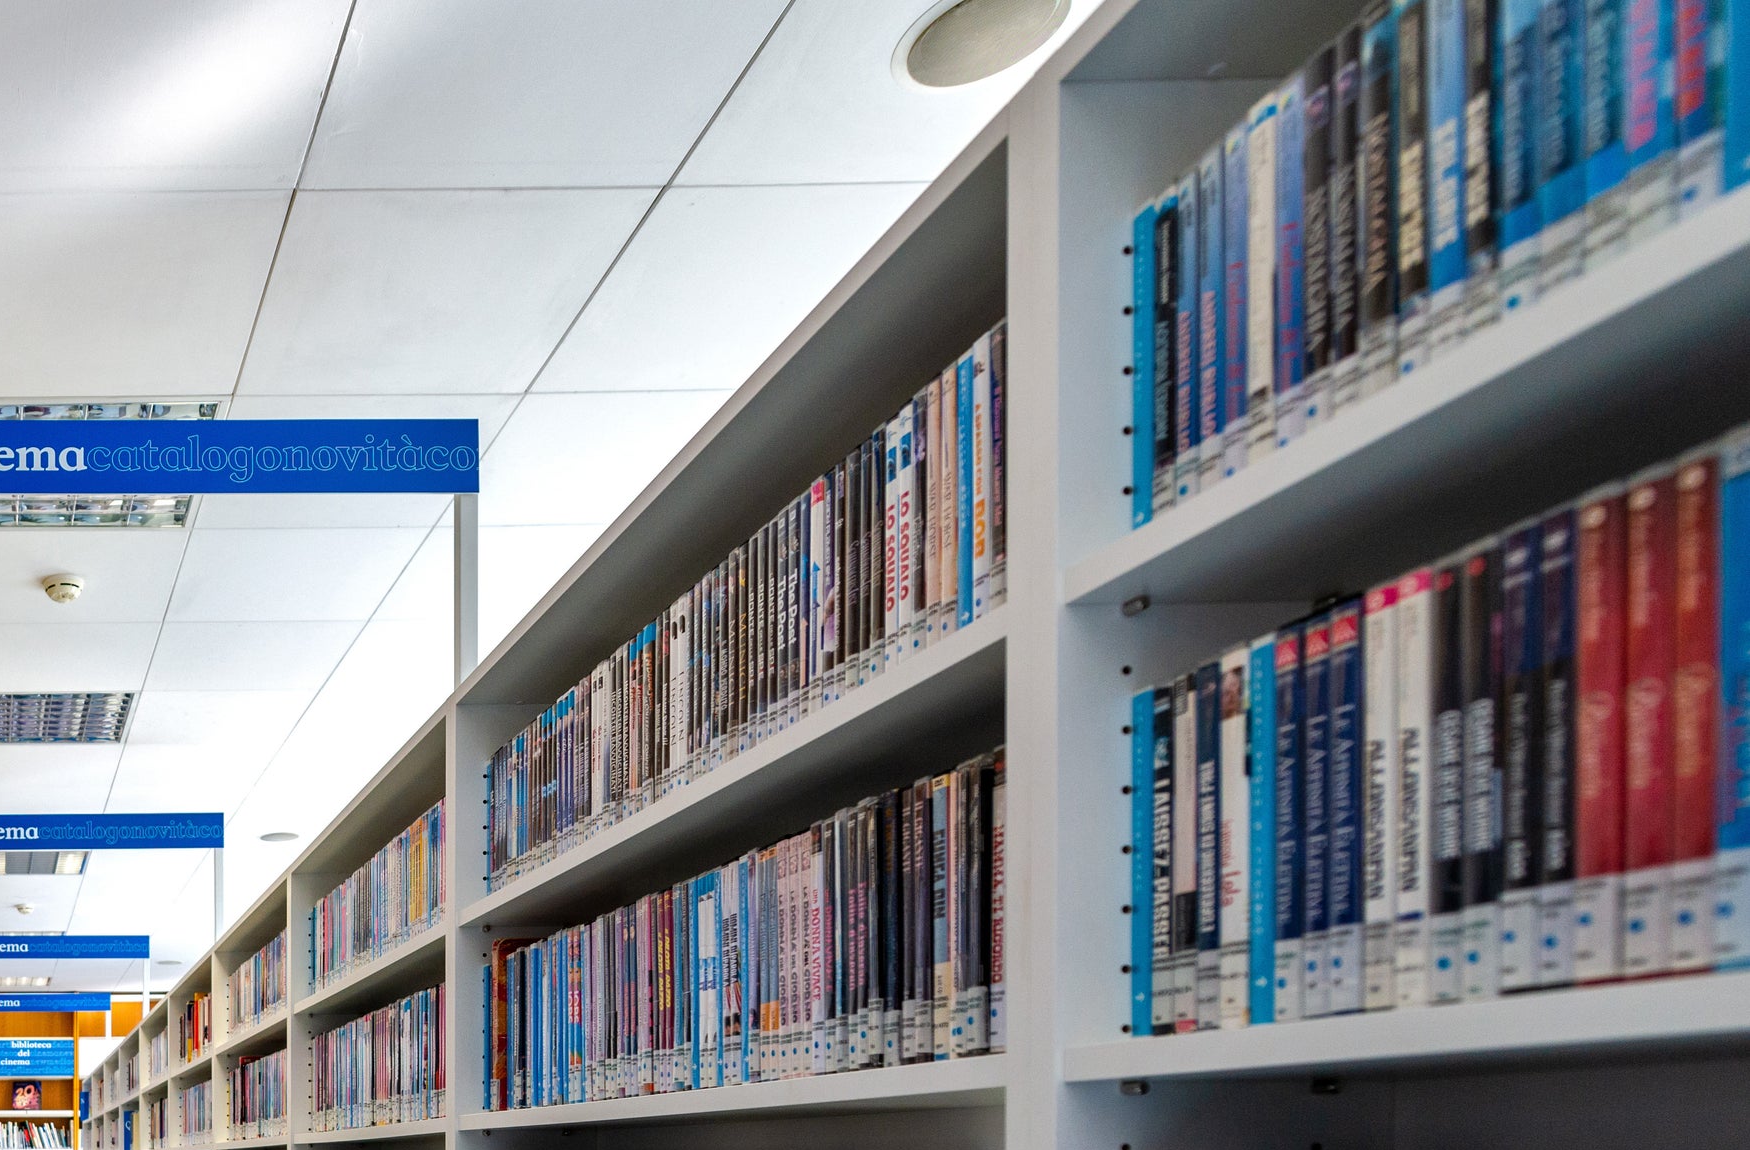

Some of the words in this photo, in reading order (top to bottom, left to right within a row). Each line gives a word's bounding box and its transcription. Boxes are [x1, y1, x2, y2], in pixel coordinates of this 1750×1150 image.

[975, 403, 983, 411] A
[975, 413, 983, 465] SPASSO
[975, 468, 983, 496] CON
[887, 505, 895, 530] LO
[975, 498, 985, 560] BOB
[887, 535, 895, 612] SQUALO
[778, 576, 786, 610] The
[778, 612, 786, 650] Post
[803, 887, 811, 898] LA
[858, 882, 866, 919] Follie
[992, 895, 1004, 913] TI
[730, 913, 738, 943] UOMINI
[803, 901, 811, 949] DONNA
[812, 907, 821, 958] DONNA
[730, 945, 738, 953] DI
[803, 950, 811, 967] DEL
[858, 923, 866, 986] d'inverno
[992, 917, 1004, 984] RICORDO
[730, 955, 738, 984] PAROLA
[812, 960, 821, 1001] VIVACE
[803, 969, 811, 1022] GIORNO
[11, 1040, 52, 1049] biblioteca
[17, 1049, 30, 1057] del
[0, 1058, 31, 1066] cinema
